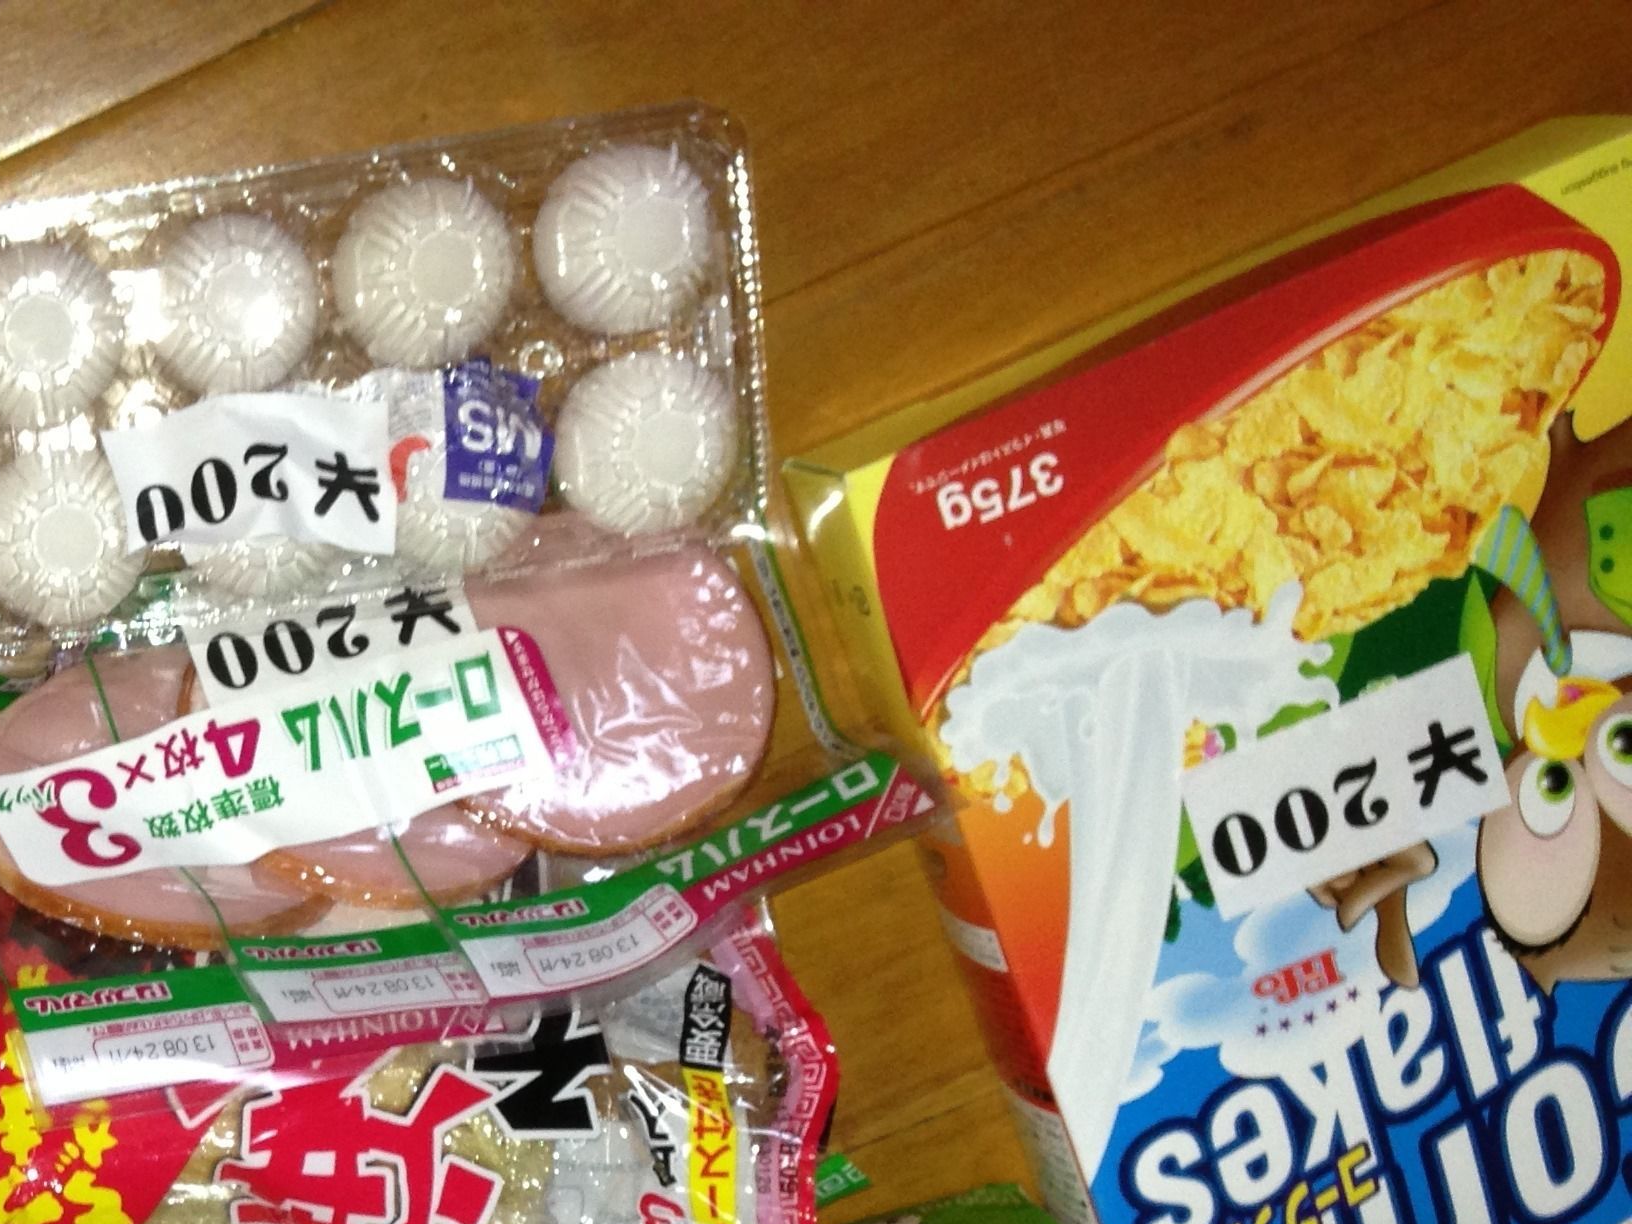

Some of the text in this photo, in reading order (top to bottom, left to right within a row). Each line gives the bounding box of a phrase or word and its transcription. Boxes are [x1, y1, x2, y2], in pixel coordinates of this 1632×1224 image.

[135, 444, 380, 543] ¥200
[934, 450, 1064, 534] 375g
[200, 583, 464, 691] ¥200
[279, 652, 501, 771] ロースハム
[140, 772, 285, 839] 標準枚数
[652, 759, 881, 880] ロースハム
[1210, 720, 1488, 879] ¥200
[700, 815, 864, 901] LOINHAM
[685, 972, 726, 1065] 要冷蔵
